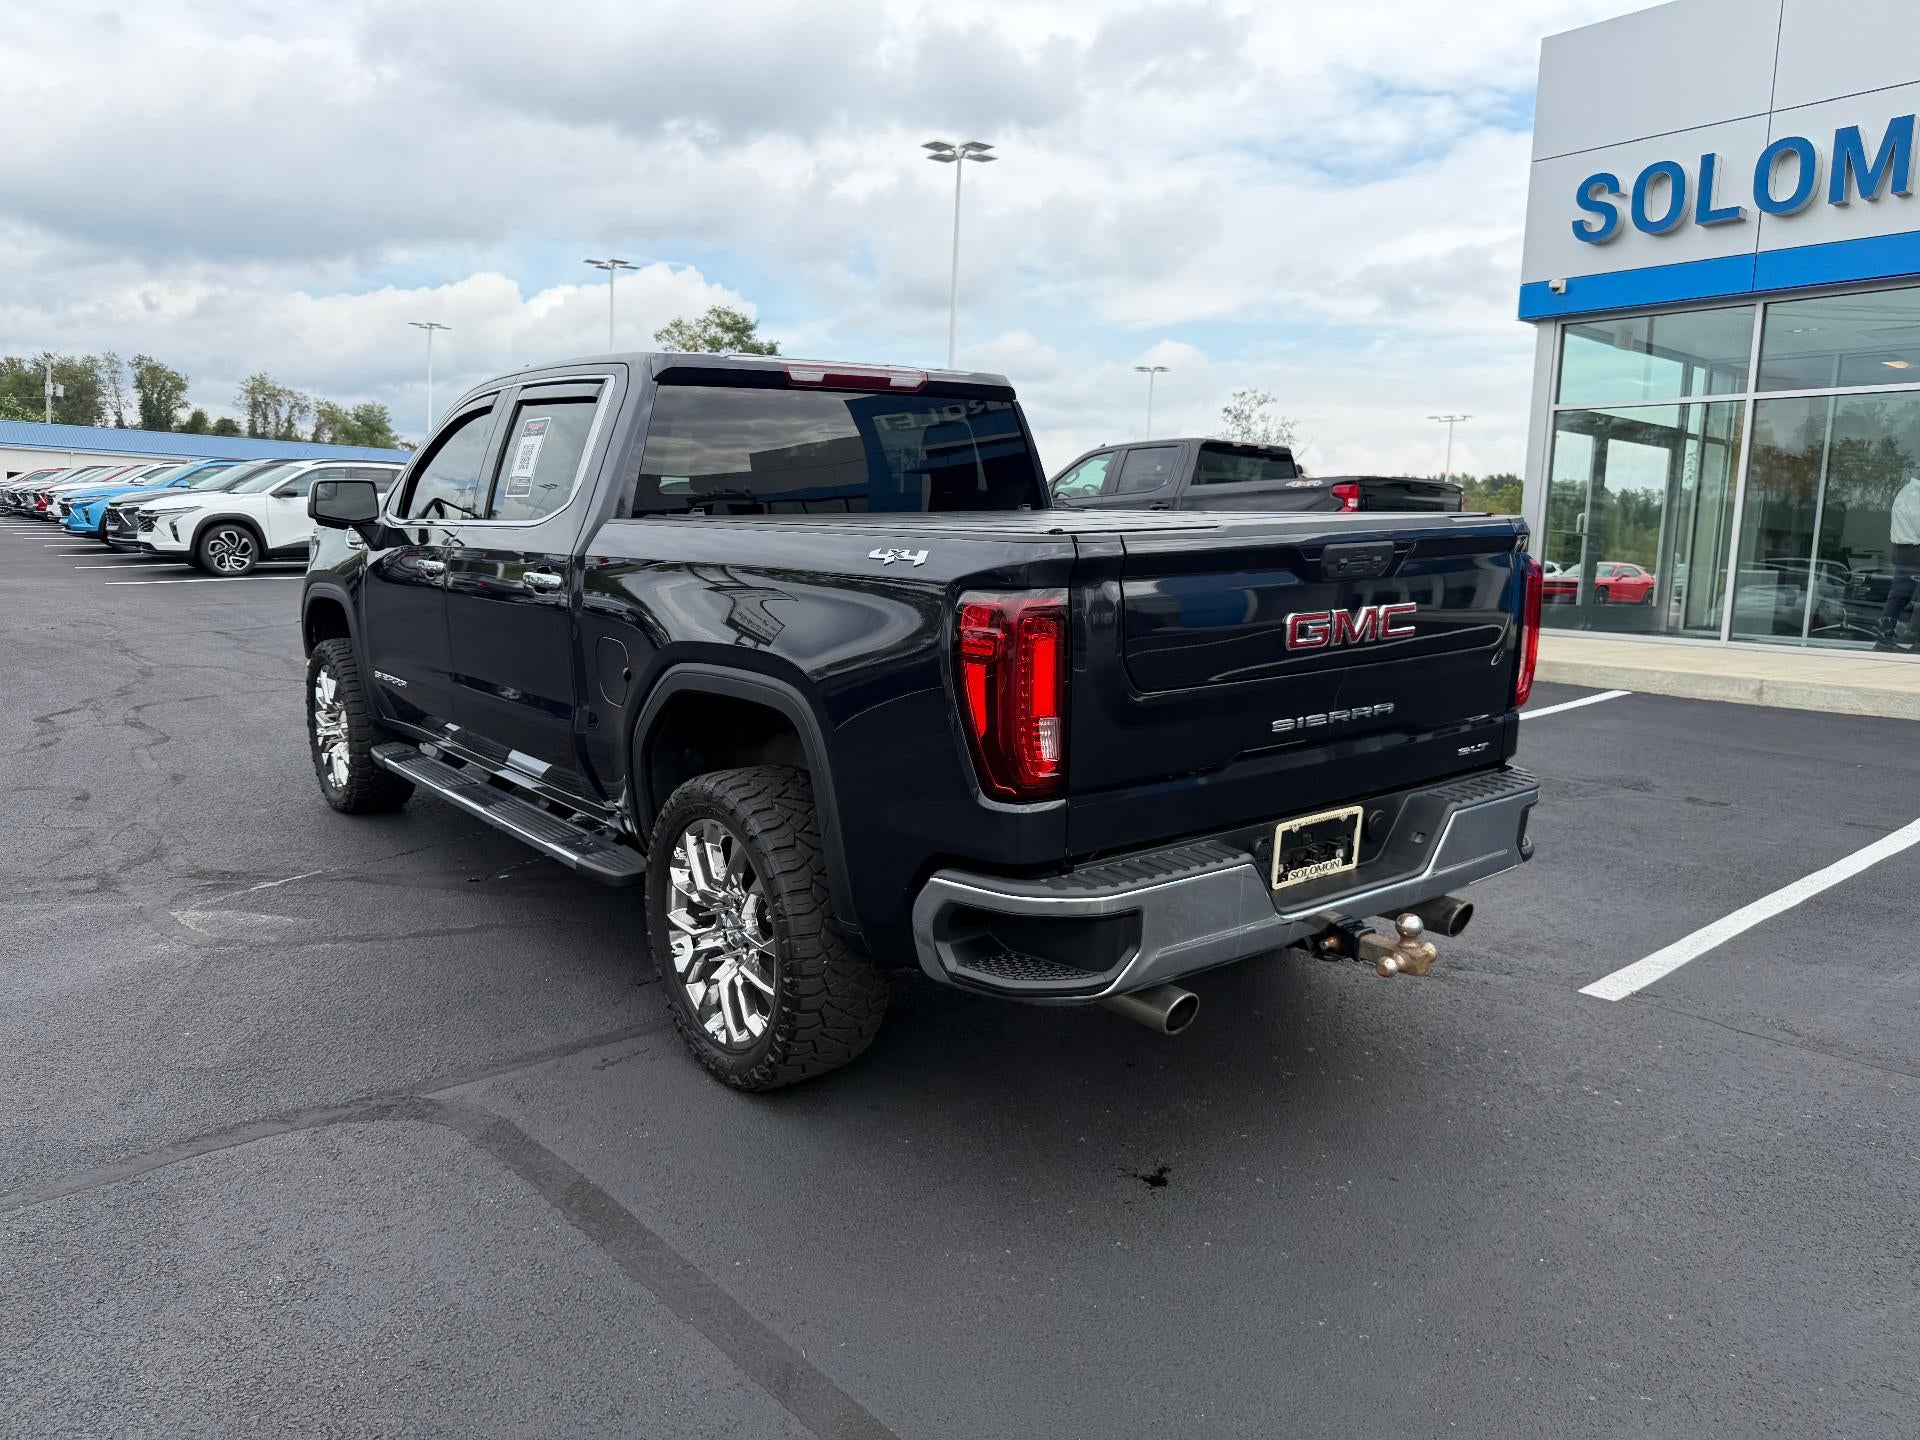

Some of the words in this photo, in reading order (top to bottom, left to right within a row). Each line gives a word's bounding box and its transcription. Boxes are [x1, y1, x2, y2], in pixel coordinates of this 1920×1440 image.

[1571, 114, 1917, 244] SOLOM
[1284, 602, 1417, 650] GMC
[1271, 702, 1395, 732] SIERRA
[1457, 741, 1490, 756] SLT
[1290, 860, 1340, 880] SOLOMON
